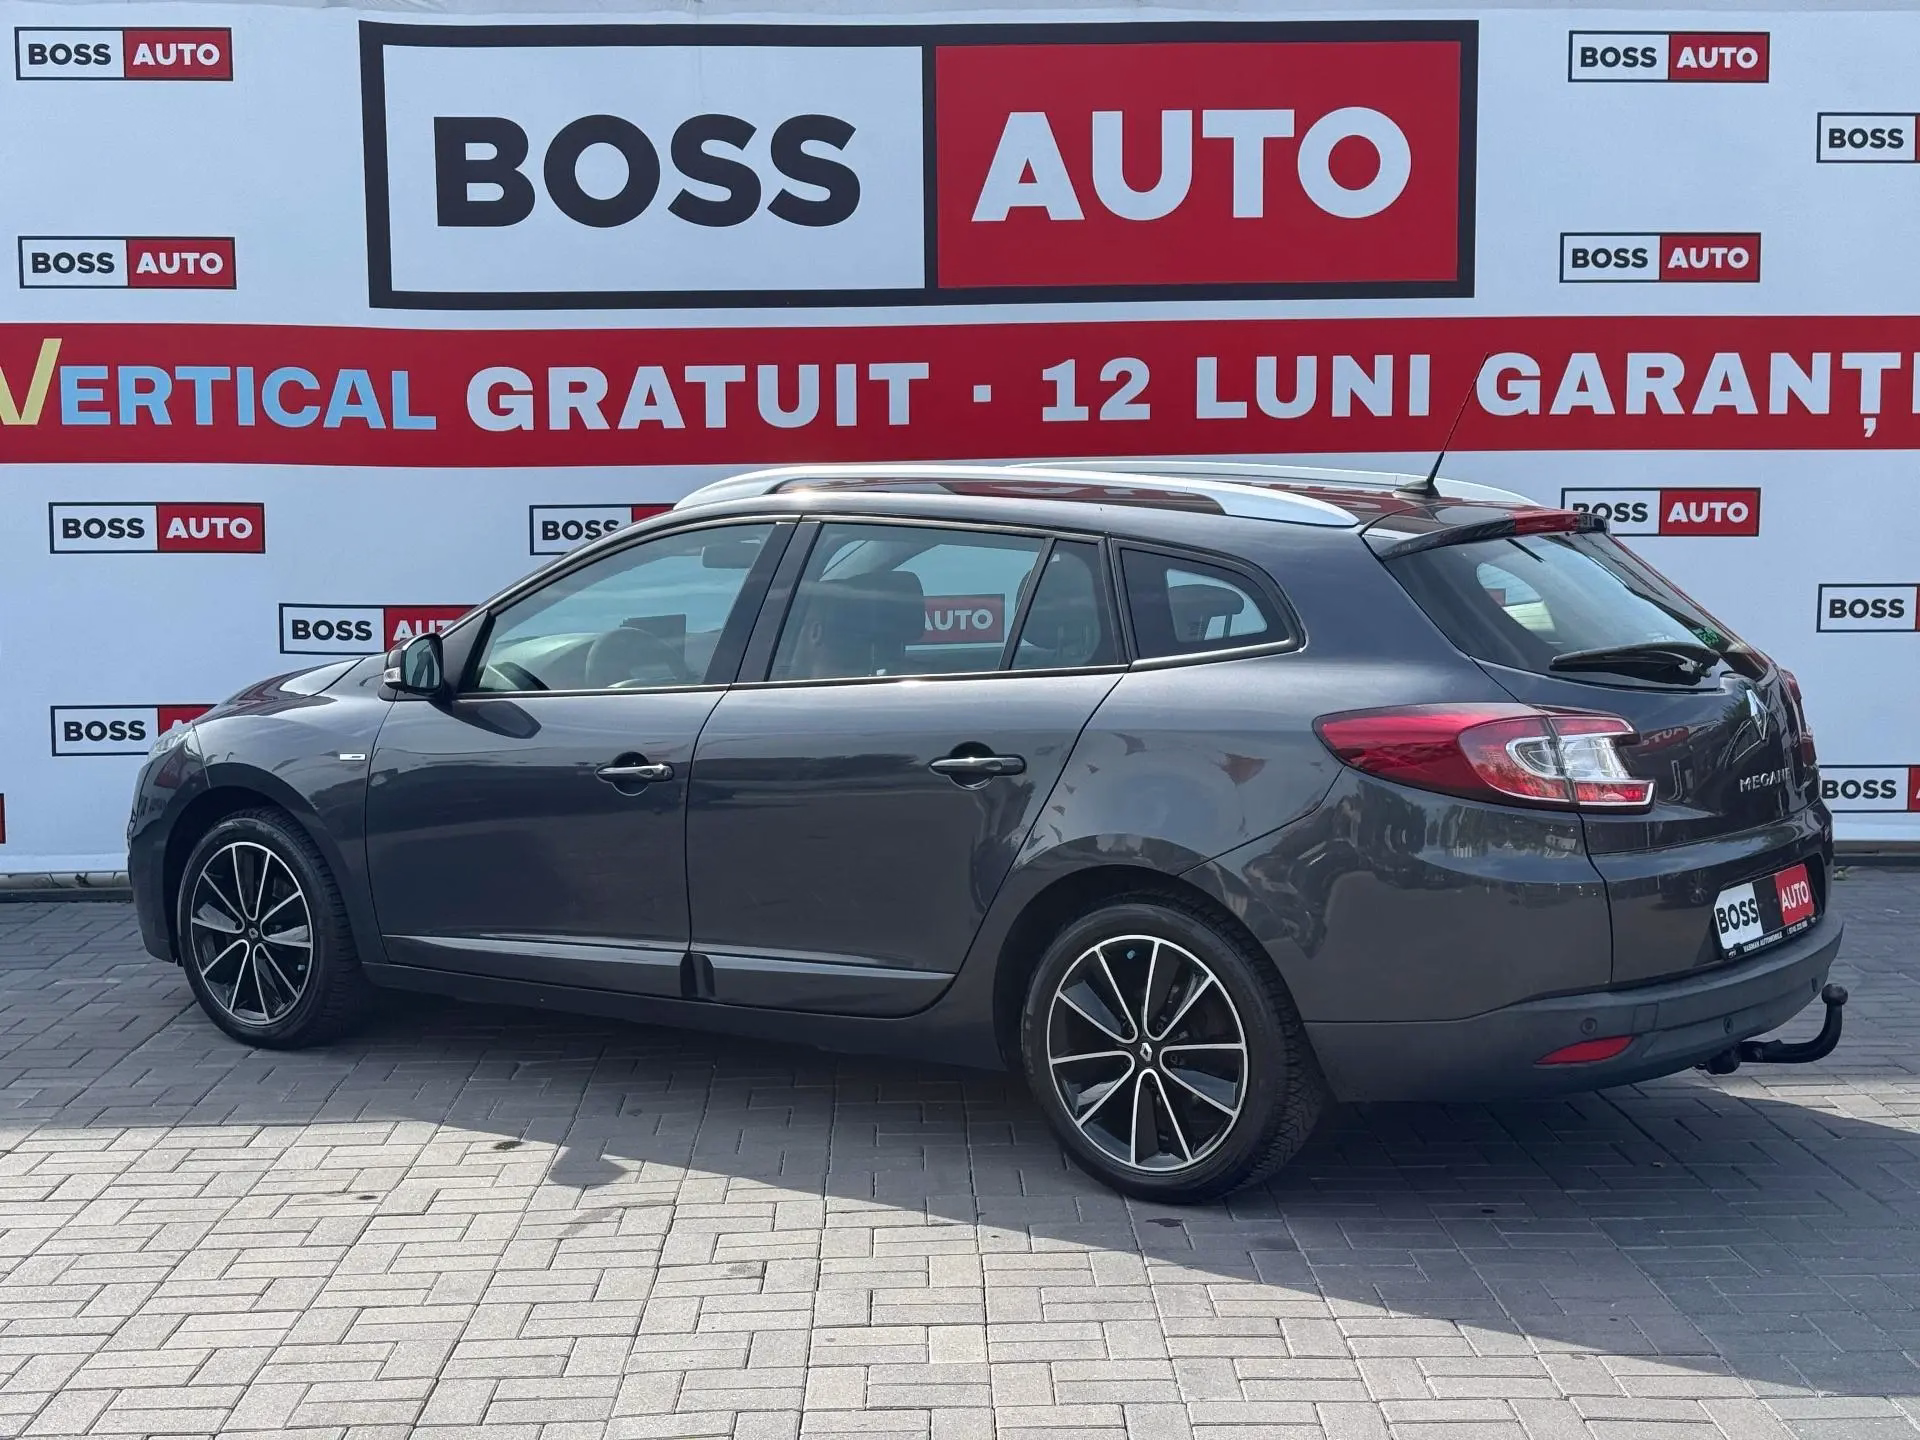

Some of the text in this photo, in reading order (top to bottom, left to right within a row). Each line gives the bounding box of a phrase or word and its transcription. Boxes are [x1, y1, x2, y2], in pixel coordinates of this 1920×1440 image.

[29, 43, 220, 66] BOSS AUTO
[1580, 47, 1758, 68] BOSS AUTO
[1828, 128, 1904, 148] BOSS
[434, 106, 1411, 228] BOSS AUTO
[32, 252, 223, 274] BOSS AUTO
[1571, 248, 1749, 268] BOSS AUTO
[467, 363, 929, 432] GRATUIT
[1042, 357, 1151, 422] 12
[1196, 355, 1430, 419] LUNI
[1667, 502, 1748, 523] AUTO
[63, 518, 253, 539] BOSS AUTO
[1829, 599, 1904, 618] BOSS
[292, 619, 372, 641] BOSS
[64, 721, 146, 742] BOSS
[1739, 767, 1791, 793] MEGANE
[1822, 779, 1896, 799] BOSS
[1716, 898, 1759, 934] BOSS
[1781, 880, 1809, 912] AUTO
